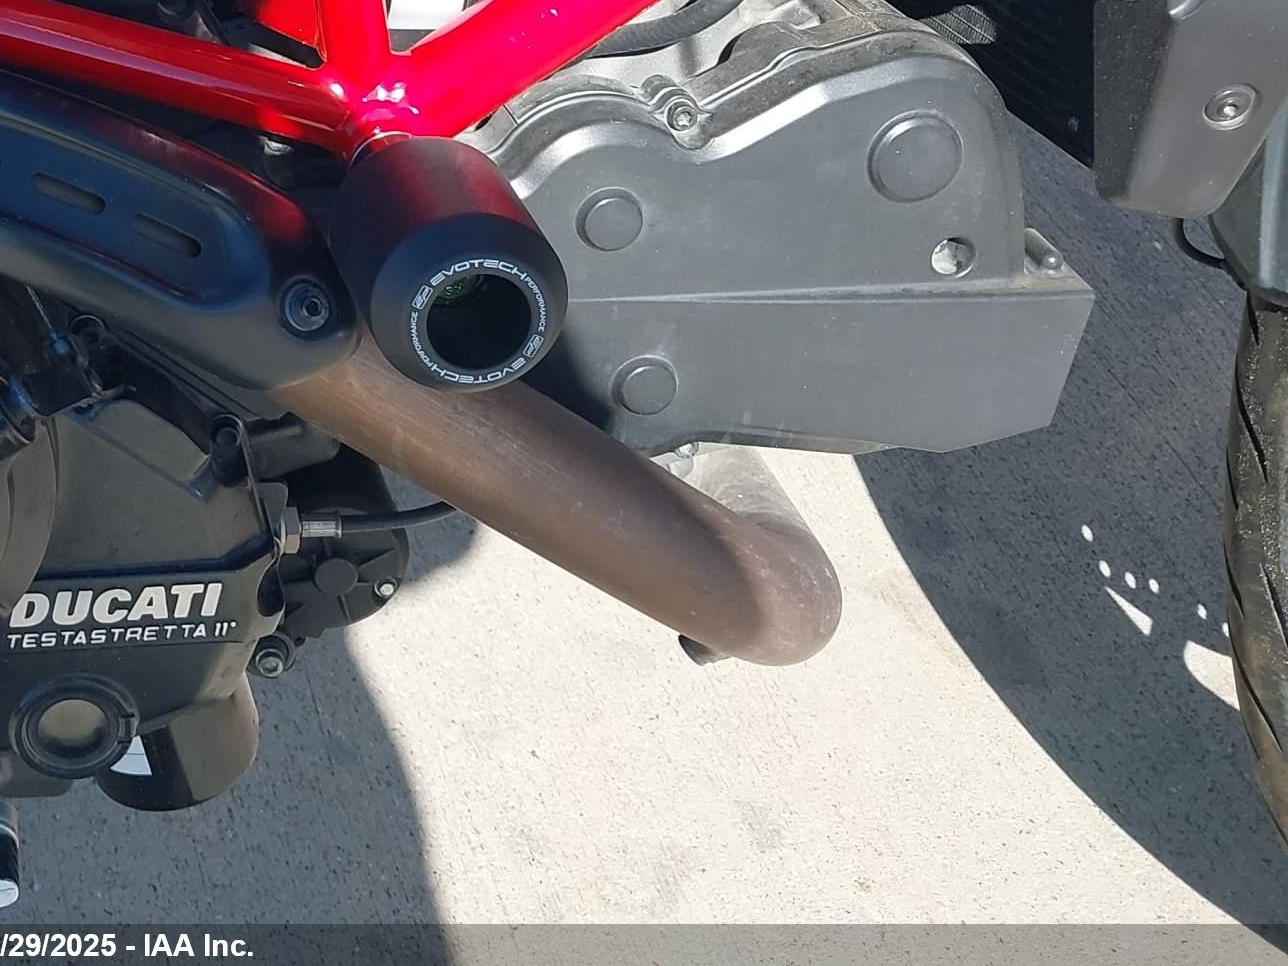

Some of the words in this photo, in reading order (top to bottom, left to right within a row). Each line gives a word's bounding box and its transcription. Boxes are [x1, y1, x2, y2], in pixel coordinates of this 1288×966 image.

[429, 258, 526, 287] EVOTECH
[524, 276, 548, 333] PERFORMANCE
[410, 311, 434, 368] PERFORMANCE
[431, 357, 527, 385] EVOTECH
[9, 582, 223, 628] DUCATI
[7, 624, 206, 649] TESTASTRETTA
